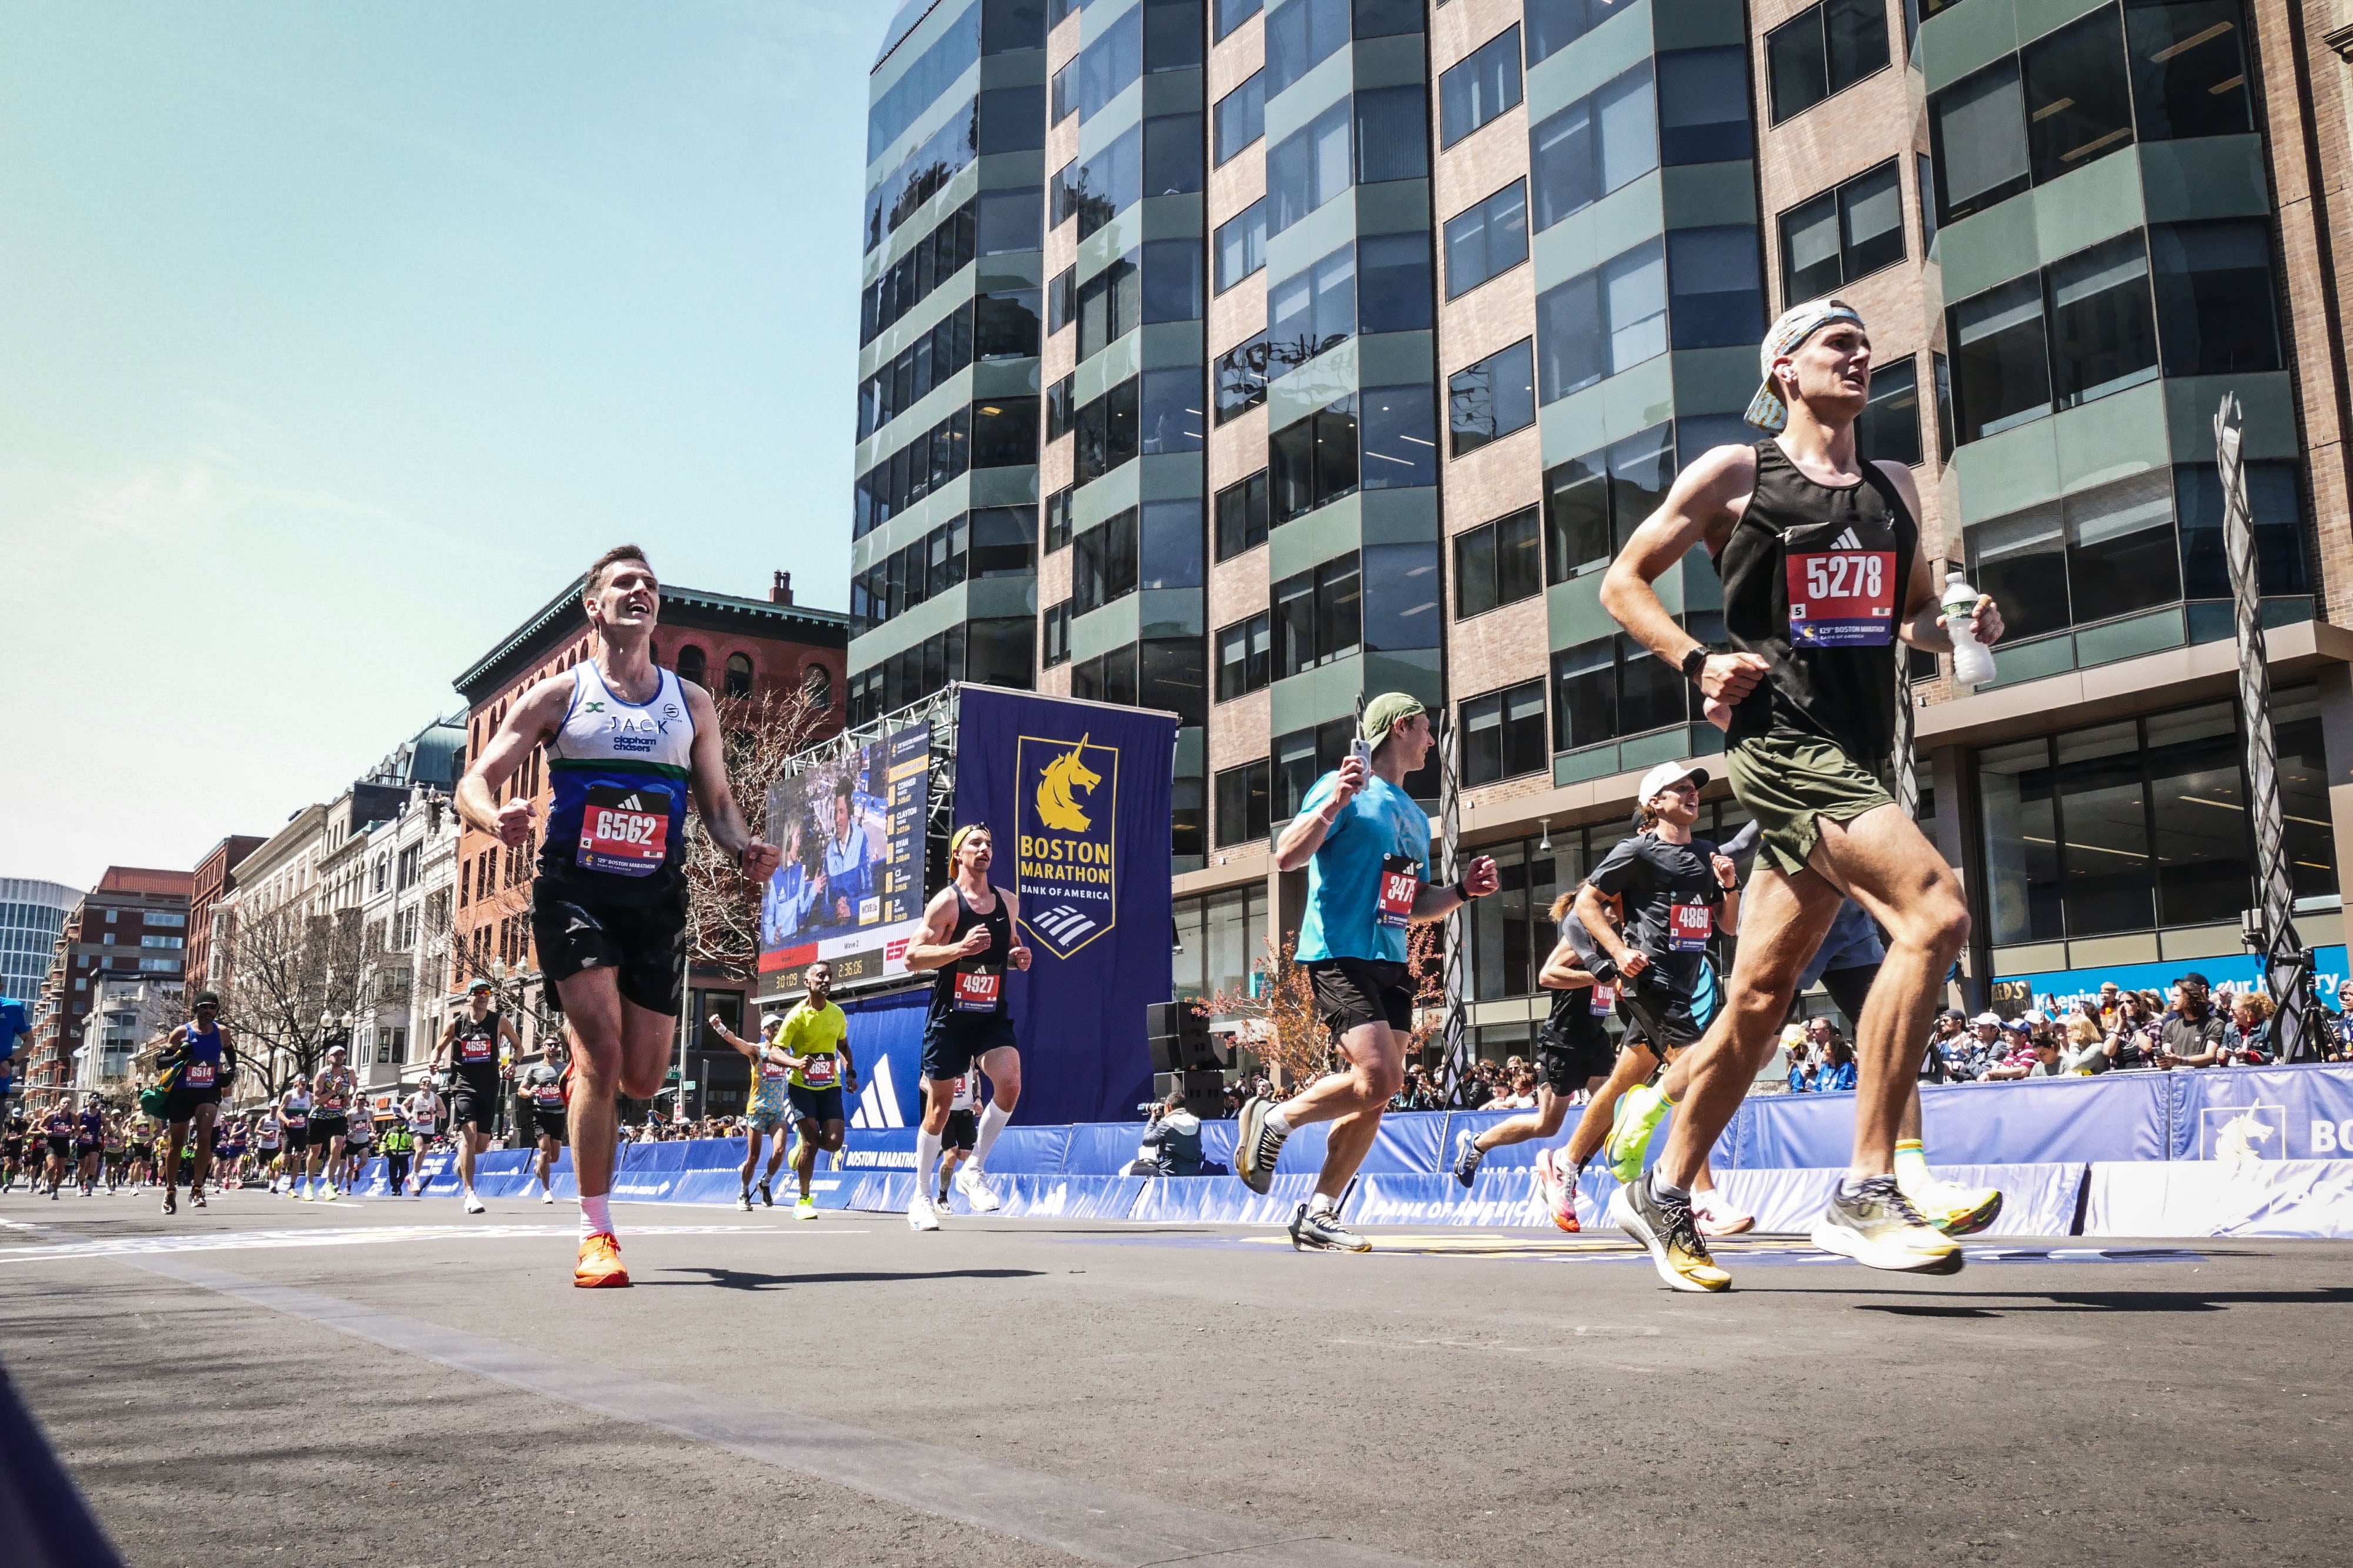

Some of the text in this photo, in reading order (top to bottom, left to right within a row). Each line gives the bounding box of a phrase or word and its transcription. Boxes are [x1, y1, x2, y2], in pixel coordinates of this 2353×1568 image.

[1807, 555, 1882, 599] 5278
[611, 716, 669, 734] JACK
[614, 736, 656, 747] clapham
[614, 743, 651, 752] chasers
[898, 778, 916, 790] CONNER
[896, 806, 917, 820] CLAYTON
[596, 811, 656, 845] 6562
[895, 838, 909, 849] RYAN
[1021, 835, 1109, 865] BOSTON
[1021, 861, 1109, 883] MARATHON
[1021, 885, 1109, 900] BANK OF AMERICA
[1679, 908, 1709, 928] 4860
[844, 942, 853, 950] Wave
[838, 960, 862, 978] 2:36:06
[962, 975, 994, 993] 4927
[466, 1041, 486, 1052] 4655
[191, 1067, 211, 1077] 6514
[809, 1062, 830, 1074] 3652
[846, 1151, 918, 1168] BOSTON MARATHO
[1373, 1200, 1532, 1225] BANK OF AMERIC
